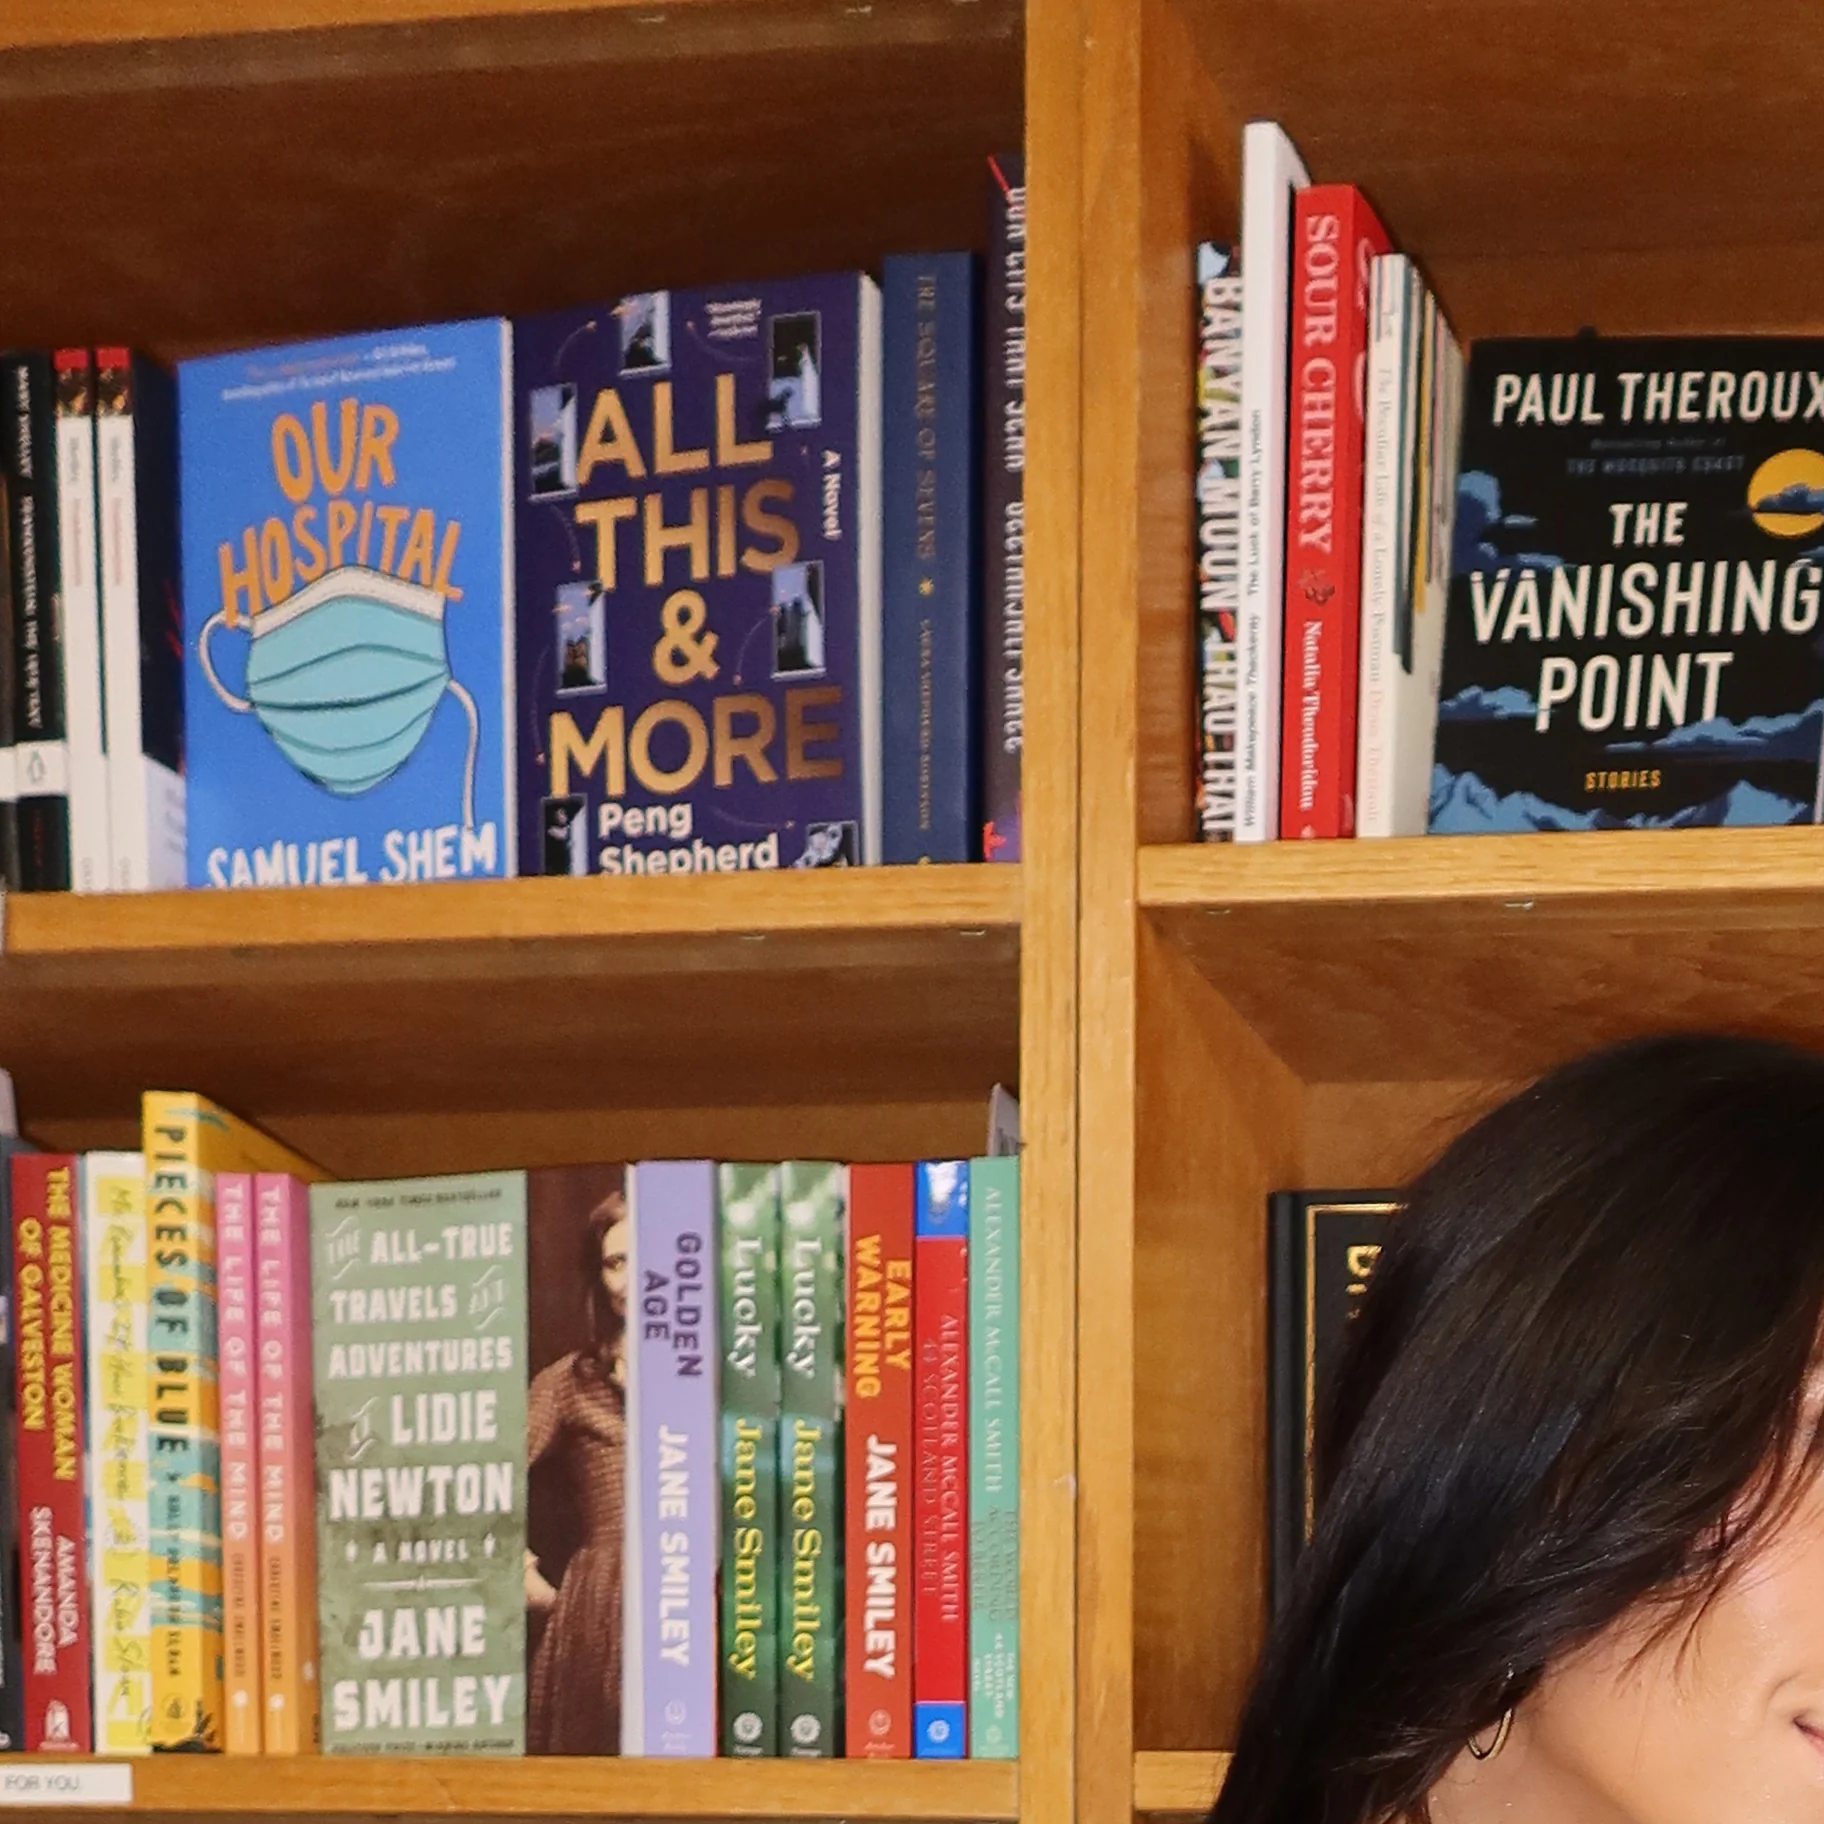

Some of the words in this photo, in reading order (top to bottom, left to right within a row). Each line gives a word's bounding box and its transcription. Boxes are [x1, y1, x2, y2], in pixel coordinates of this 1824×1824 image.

[1302, 212, 1339, 348] SOUR
[576, 373, 775, 484] ALL
[1491, 372, 1604, 426] PAUL
[271, 399, 400, 495] OUR
[1299, 357, 1338, 553] CHERRY
[218, 499, 465, 626] HOSPITAL
[574, 478, 801, 591] THIS
[1610, 502, 1688, 547] THE
[654, 589, 722, 684] &
[1469, 559, 1824, 642] VANISHING
[1534, 651, 1734, 732] POINT
[548, 686, 845, 798] MORE
[1585, 769, 1661, 792] STORIES
[206, 837, 367, 890] SAMUEL
[382, 823, 498, 885] SHEM
[599, 804, 694, 841] Peng
[599, 835, 779, 875] Shepherd
[20, 1216, 41, 1255] OF
[46, 1166, 72, 1215] THE
[150, 1124, 190, 1271] PIECES
[48, 1220, 76, 1348] MEDICINE
[369, 1222, 514, 1264] ALL-TRUE
[21, 1260, 46, 1430] GALVESTON
[152, 1282, 189, 1334] OF
[329, 1290, 460, 1327] TRAVELS
[643, 1270, 669, 1342] AGE
[673, 1231, 701, 1377] GOLDEN
[853, 1233, 882, 1399] WARNING
[885, 1258, 912, 1371] EARLY
[152, 1356, 189, 1455] BLUE
[328, 1338, 514, 1379] ADVENTURES
[49, 1352, 77, 1481] WOMAN
[389, 1391, 498, 1444] LIDIE
[328, 1462, 514, 1522] NEWTON
[658, 1426, 688, 1521] JANE
[864, 1433, 897, 1533] JANE
[356, 1606, 488, 1658] JANE
[659, 1530, 690, 1668] SMILEY
[863, 1540, 897, 1679] SMILEY
[331, 1677, 514, 1731] SMILEY
